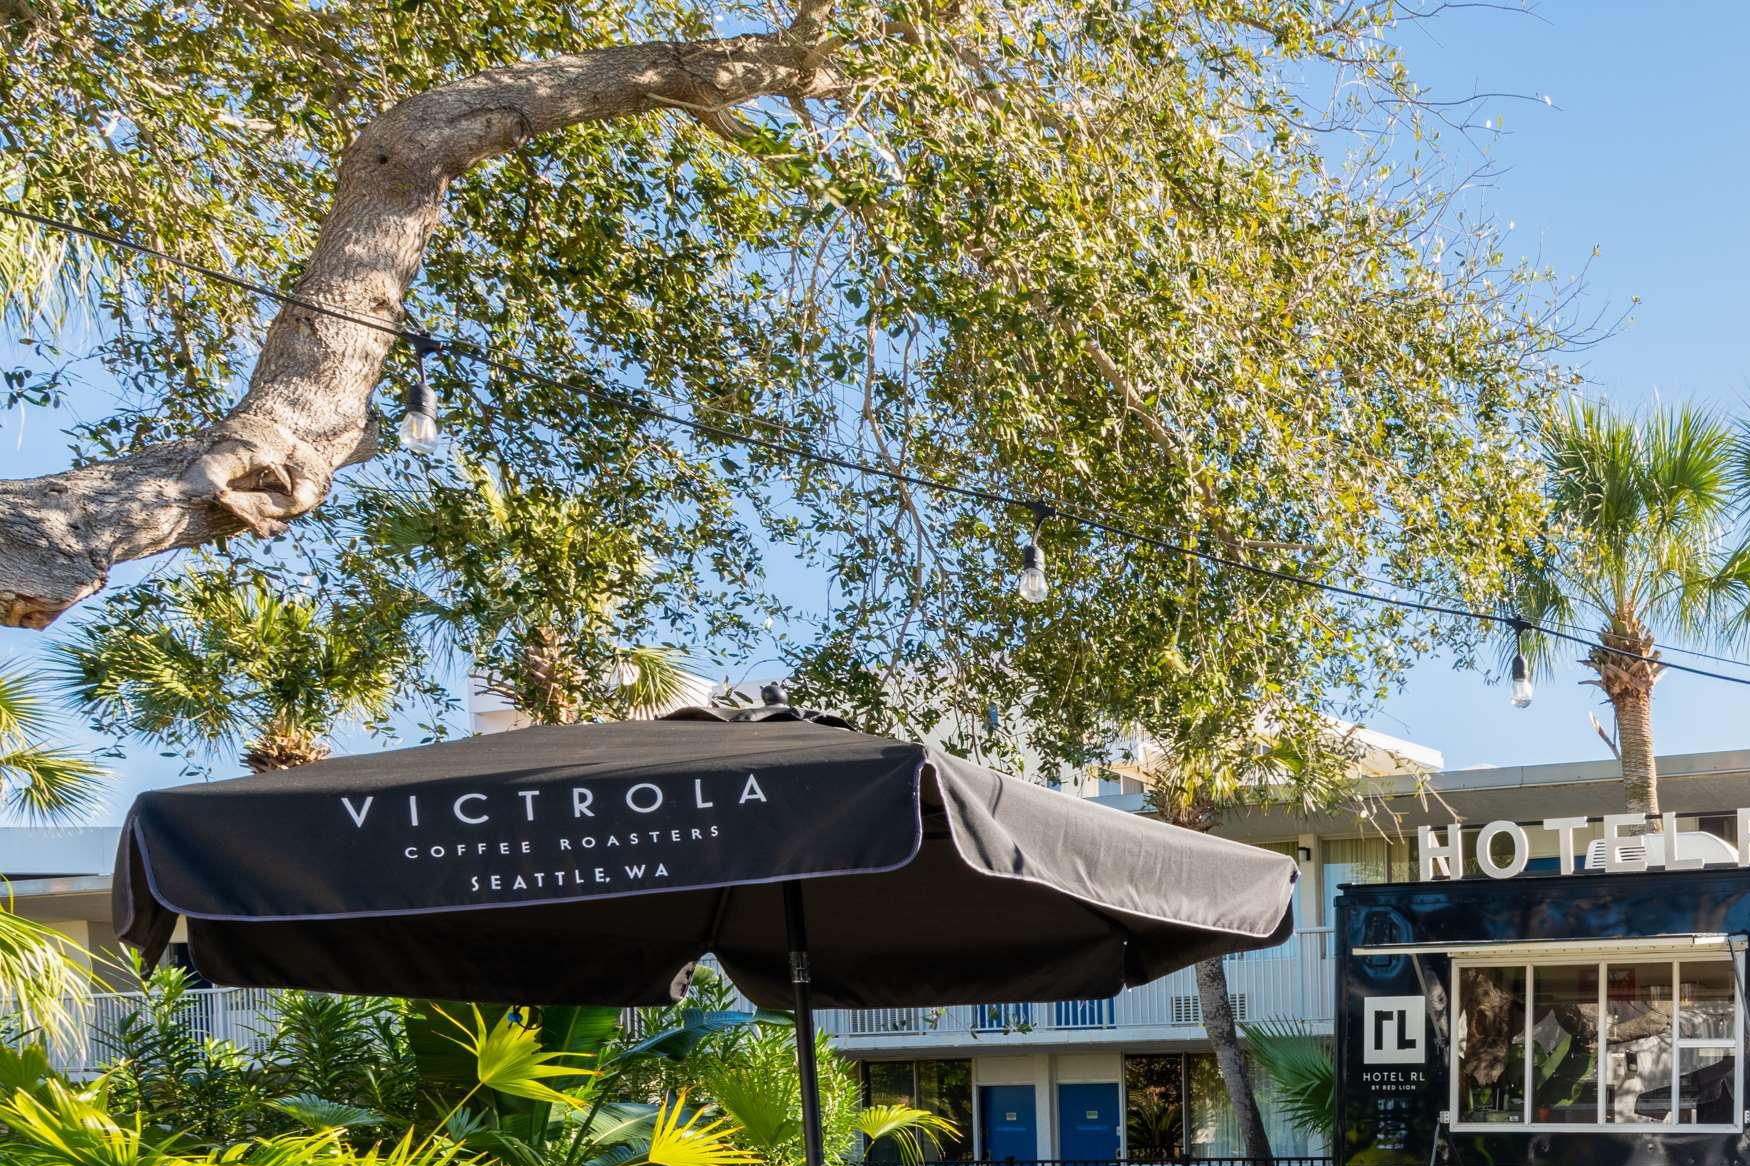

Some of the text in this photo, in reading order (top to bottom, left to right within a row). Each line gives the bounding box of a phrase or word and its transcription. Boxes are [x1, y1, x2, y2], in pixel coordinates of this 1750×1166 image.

[341, 773, 769, 830] VICTROLA
[404, 825, 720, 860] COFFEE ROASTERS
[1417, 812, 1704, 881] HOTEL
[471, 862, 670, 892] SEATTLE, WA
[1362, 1071, 1426, 1082] HOTEL RL
